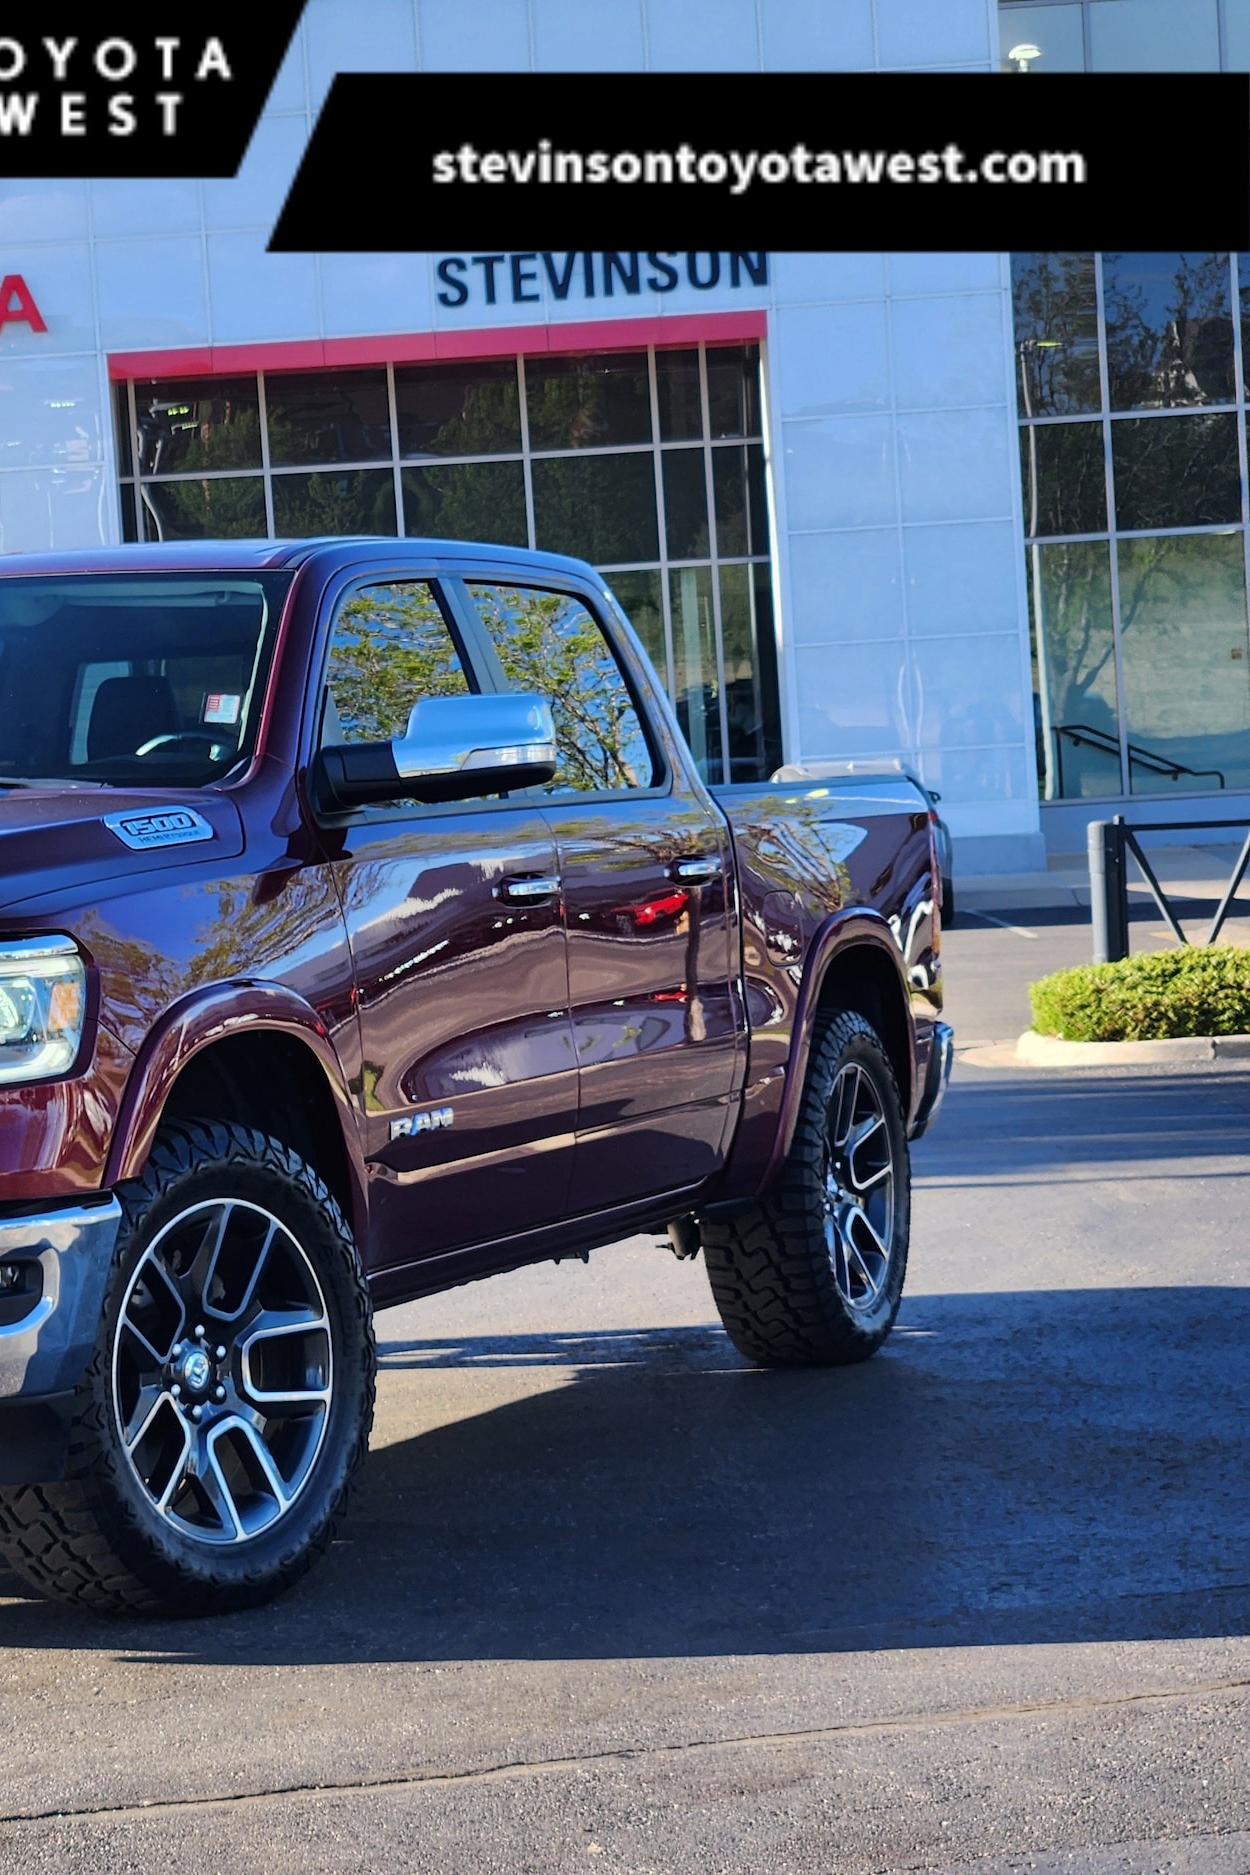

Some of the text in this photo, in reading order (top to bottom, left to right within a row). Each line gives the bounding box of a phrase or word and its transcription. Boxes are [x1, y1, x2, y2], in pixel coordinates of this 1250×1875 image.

[436, 251, 768, 307] STEVINSON
[122, 814, 192, 835] 1500
[390, 1107, 454, 1140] RAM
